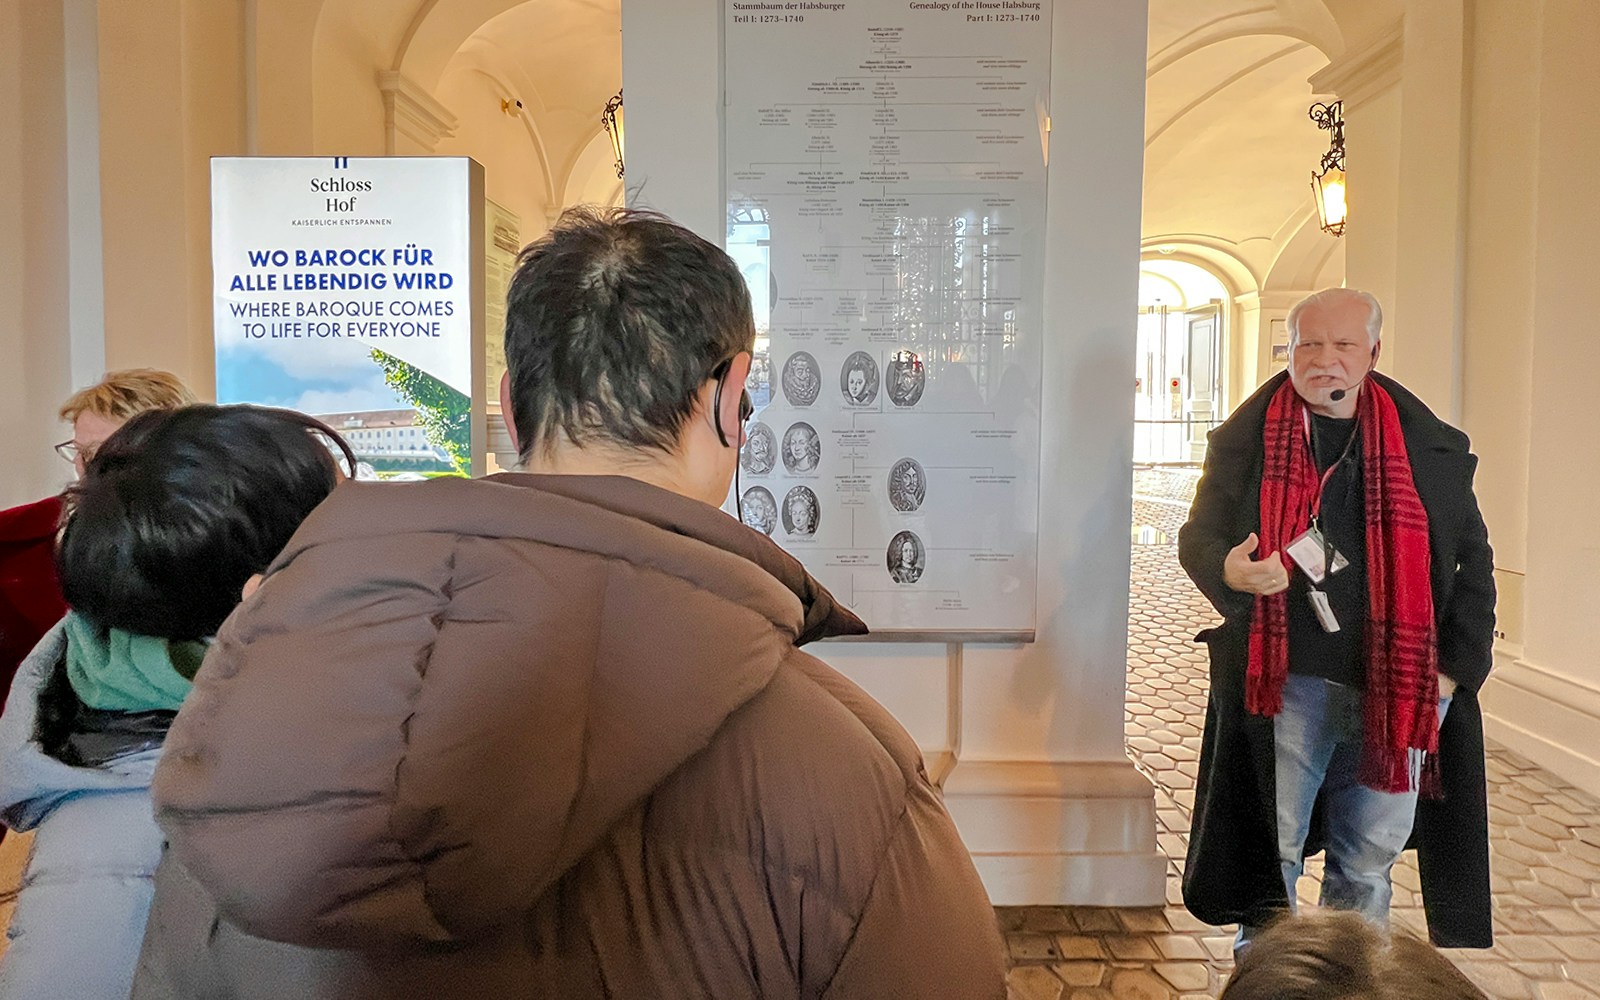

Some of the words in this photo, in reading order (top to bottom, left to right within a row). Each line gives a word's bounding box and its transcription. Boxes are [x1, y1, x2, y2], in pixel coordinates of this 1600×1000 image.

[732, 1, 784, 11] Stammbaum
[785, 1, 798, 10] der
[799, 2, 846, 12] Habsburger
[909, 1, 950, 11] Genealogy
[951, 0, 961, 10] of
[961, 0, 975, 10] the
[975, 1, 1001, 10] House
[1002, 0, 1041, 11] Habsburg
[732, 15, 749, 23] Teil
[966, 14, 984, 22] Part
[310, 176, 372, 192] Schloss
[326, 197, 357, 212] Hof
[339, 218, 392, 226] ENTSPANNEN
[248, 250, 289, 267] WO
[295, 249, 387, 266] BAROCK
[393, 243, 434, 266] FÜR
[230, 274, 277, 291] ALLE
[283, 273, 388, 291] LEBENDIG
[393, 272, 454, 290] WIRD
[229, 302, 291, 318] WHERE
[296, 301, 384, 319] BAROQUE
[389, 300, 454, 317] COMES
[243, 323, 267, 338] TO
[271, 322, 302, 338] LIFE
[307, 322, 342, 338] FOR
[347, 321, 441, 338] EVERYONE
